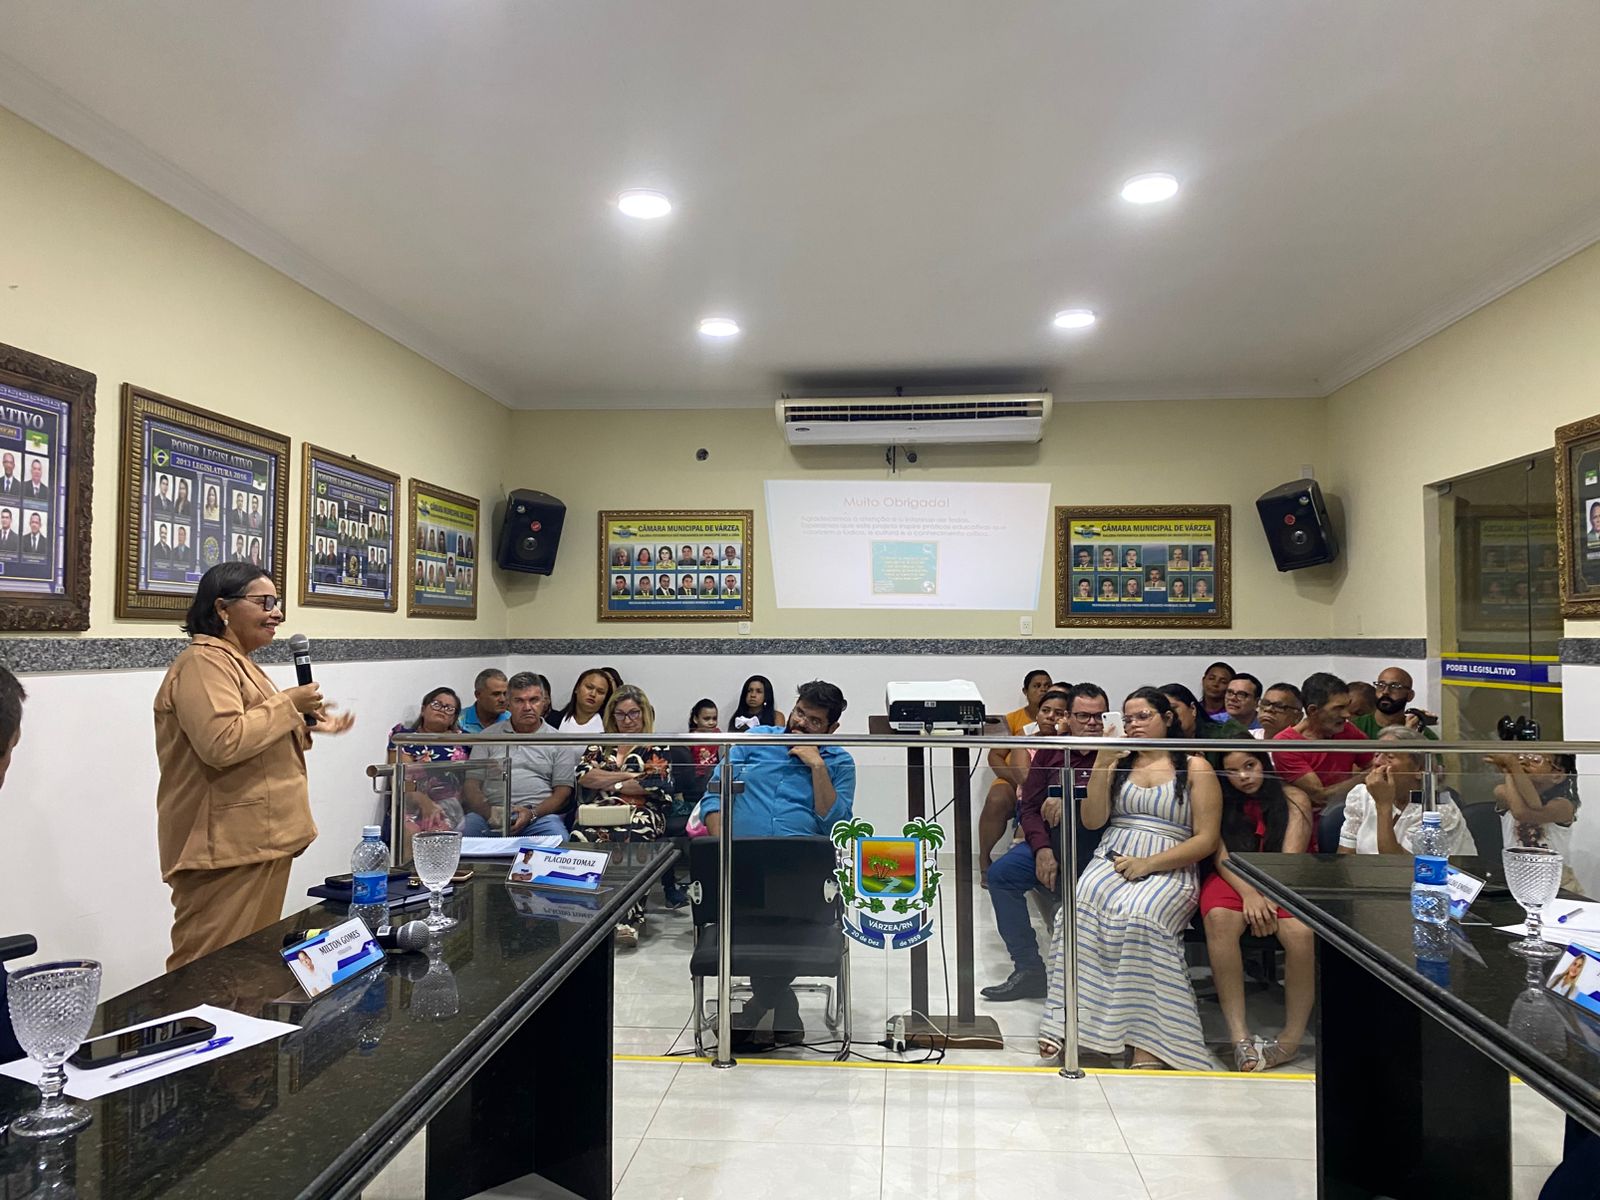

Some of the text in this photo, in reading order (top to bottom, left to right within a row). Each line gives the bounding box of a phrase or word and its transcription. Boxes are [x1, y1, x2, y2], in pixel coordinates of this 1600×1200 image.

[171, 439, 253, 469] PODER LEGISLATIVO
[192, 461, 233, 477] LEGISLATURA
[844, 497, 880, 507] Muito
[715, 524, 740, 532] VÁRZEA
[1184, 524, 1212, 532] VÁRZEA
[1446, 664, 1516, 676] PODER LEGISLATIVO
[572, 858, 596, 867] TOMAZ
[868, 919, 913, 931] VÁRZEA/RN
[318, 939, 342, 955] MILTON
[340, 930, 361, 945] GOMES
[851, 930, 859, 938] 20
[868, 938, 879, 946] Dez
